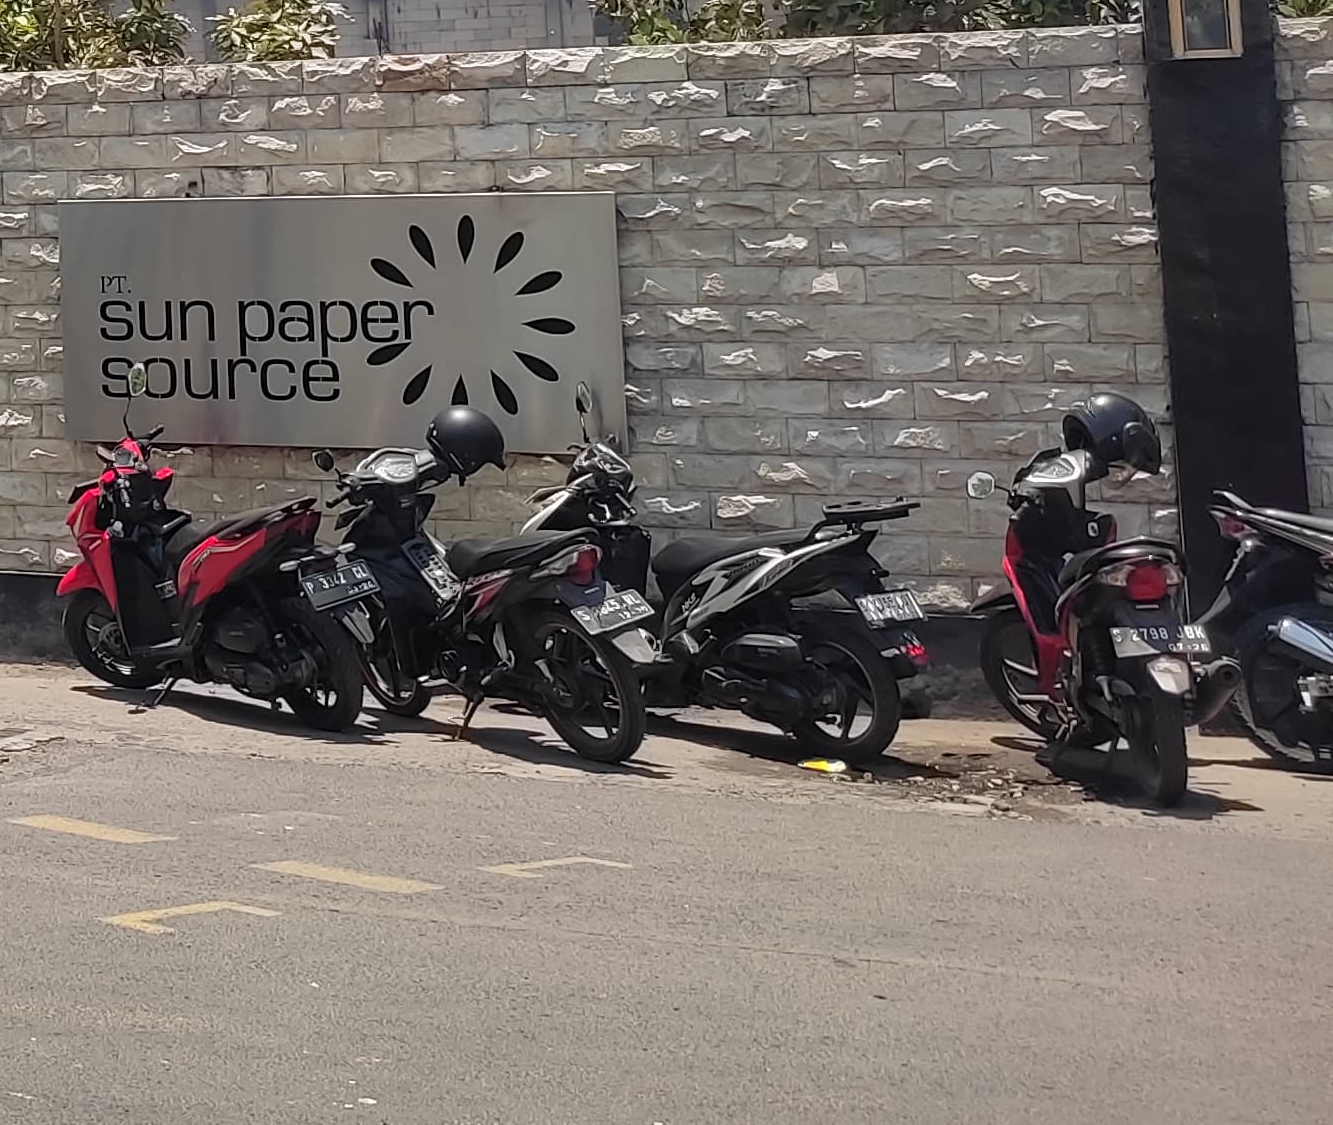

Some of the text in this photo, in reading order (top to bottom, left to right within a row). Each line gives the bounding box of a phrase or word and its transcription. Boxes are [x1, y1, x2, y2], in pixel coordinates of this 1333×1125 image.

[100, 275, 132, 294] PT.
[99, 300, 435, 358] sun paper
[101, 357, 341, 401] source
[1130, 627, 1169, 642] 2798
